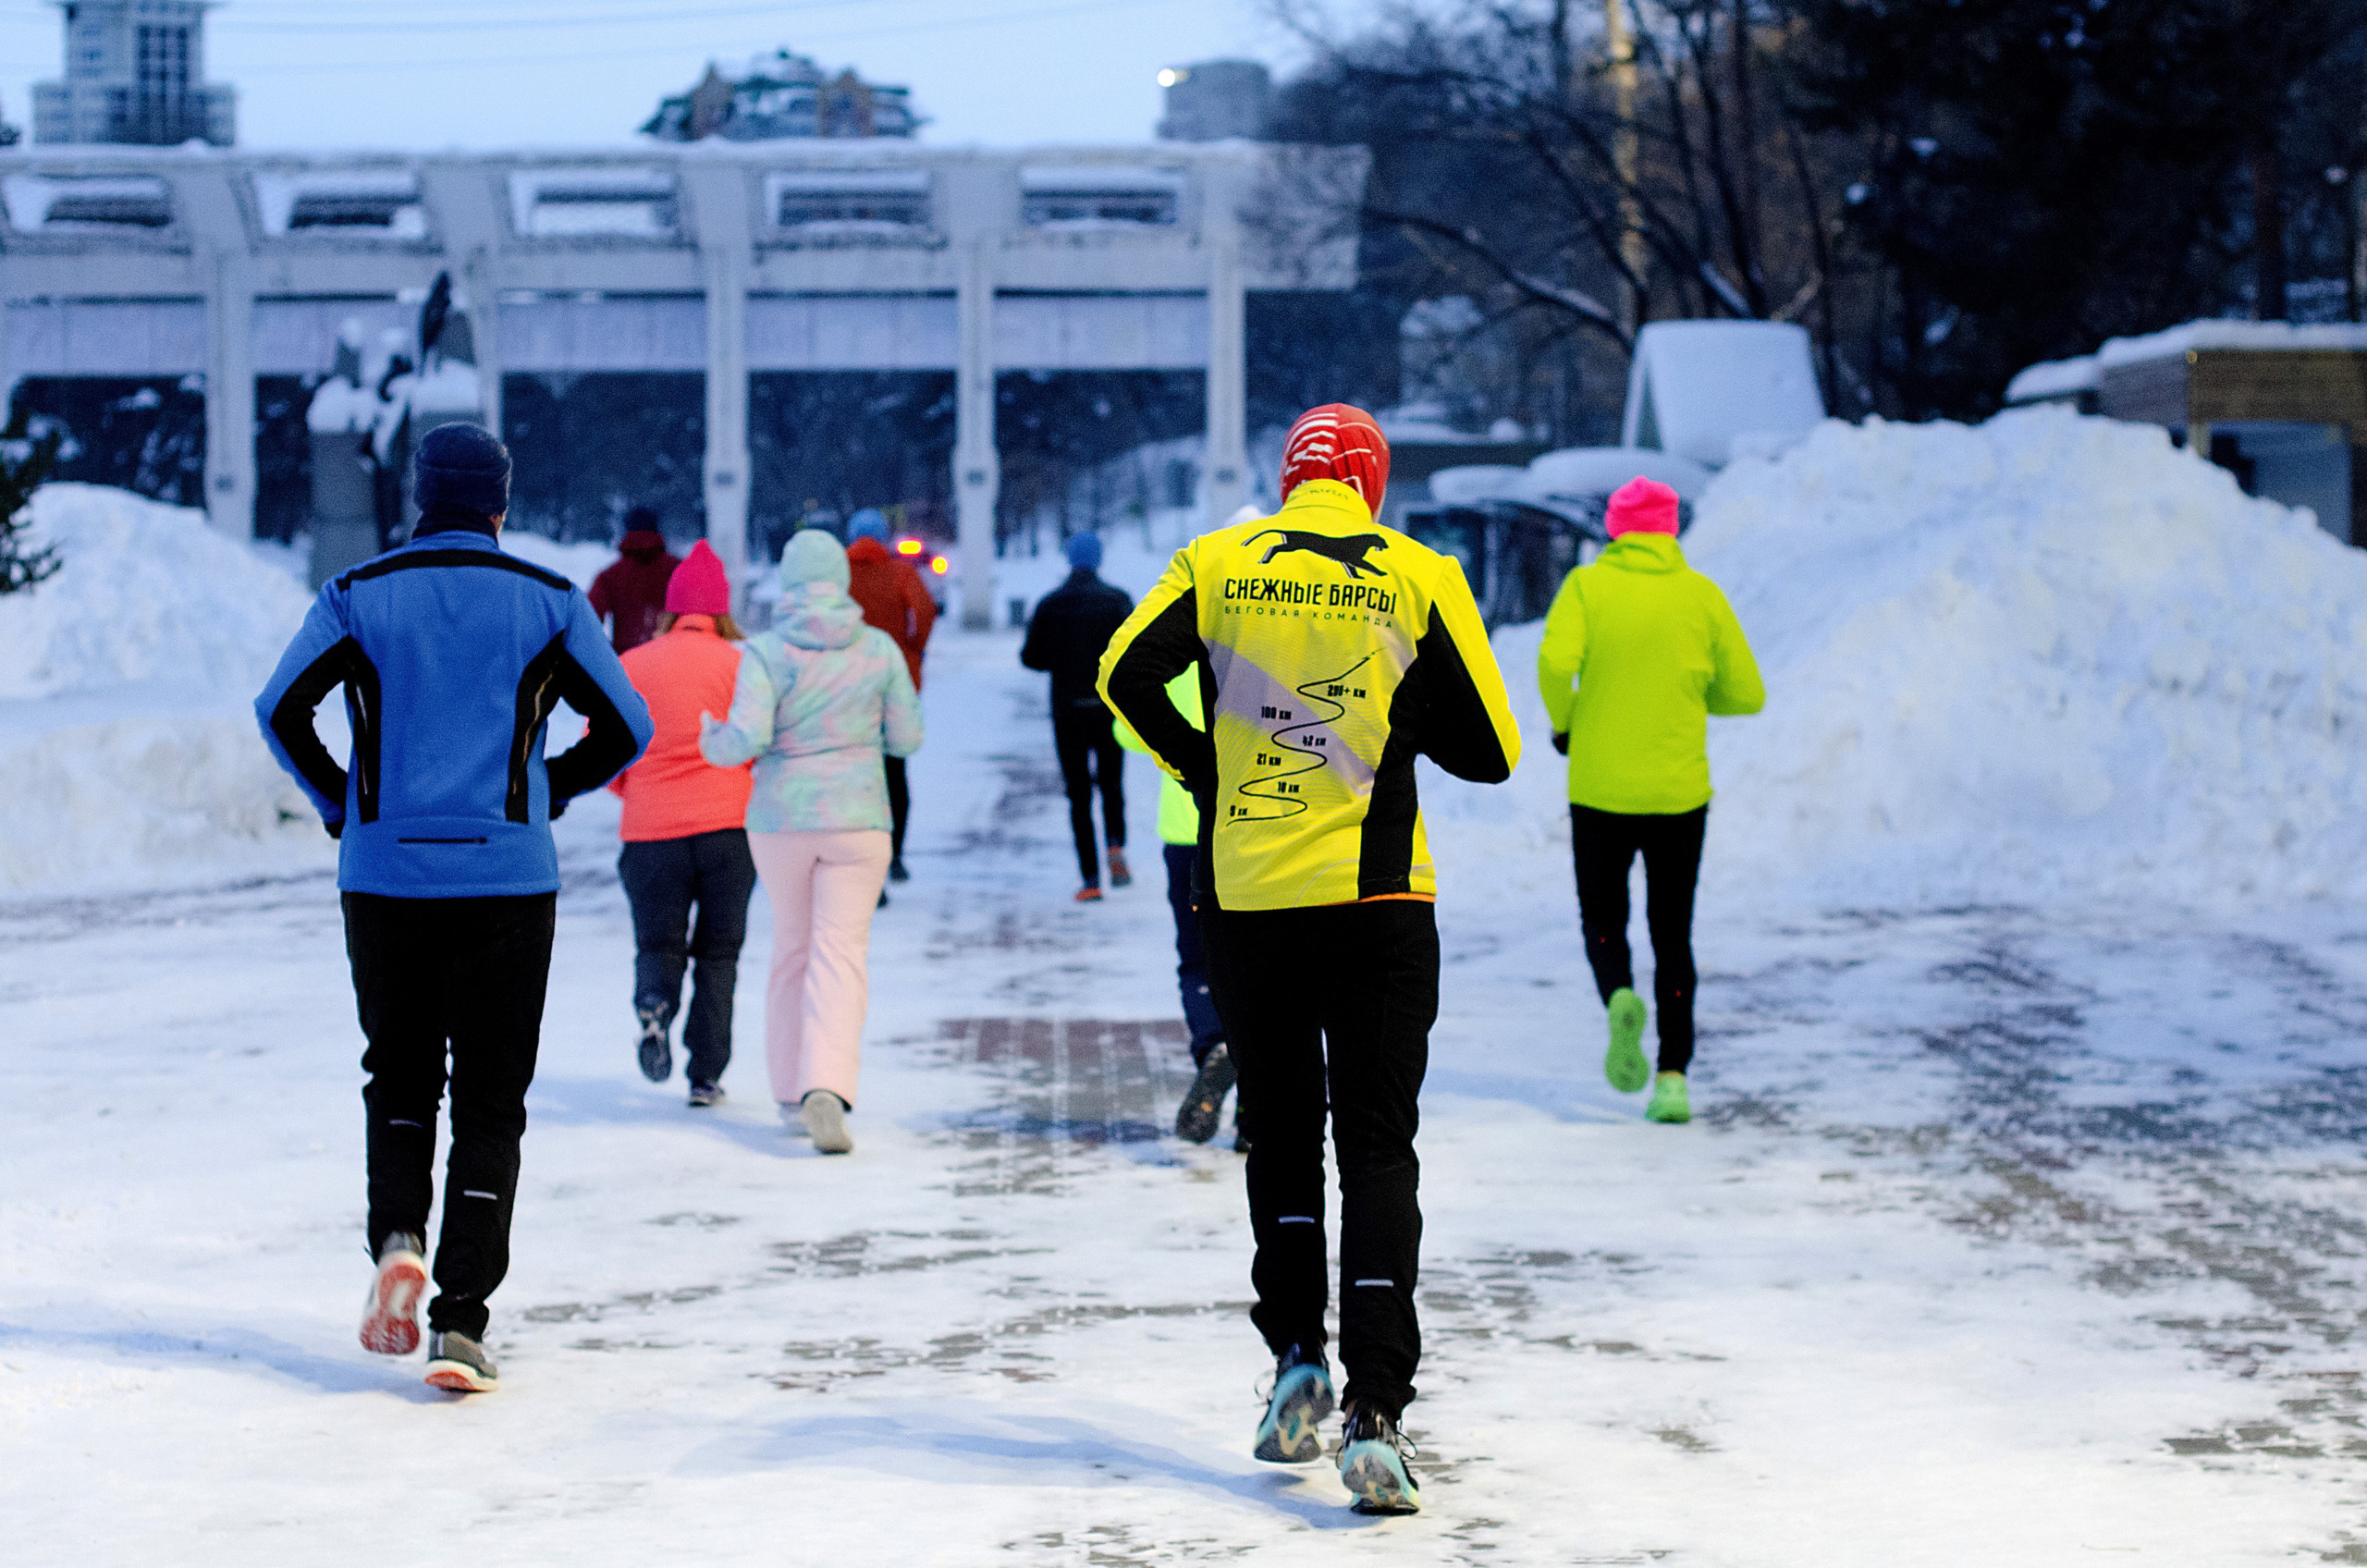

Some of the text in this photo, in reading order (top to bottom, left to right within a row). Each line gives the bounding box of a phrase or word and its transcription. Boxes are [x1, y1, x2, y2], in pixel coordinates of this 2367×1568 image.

[1224, 578, 1397, 615] СНЕЖНЫЕ БАРСЫ
[1224, 606, 1392, 629] БЕГОВАЯ КОМАНДА
[1261, 705, 1277, 719] 100
[1302, 734, 1314, 746] 42
[1257, 753, 1267, 766] 21
[1278, 781, 1286, 793] 10
